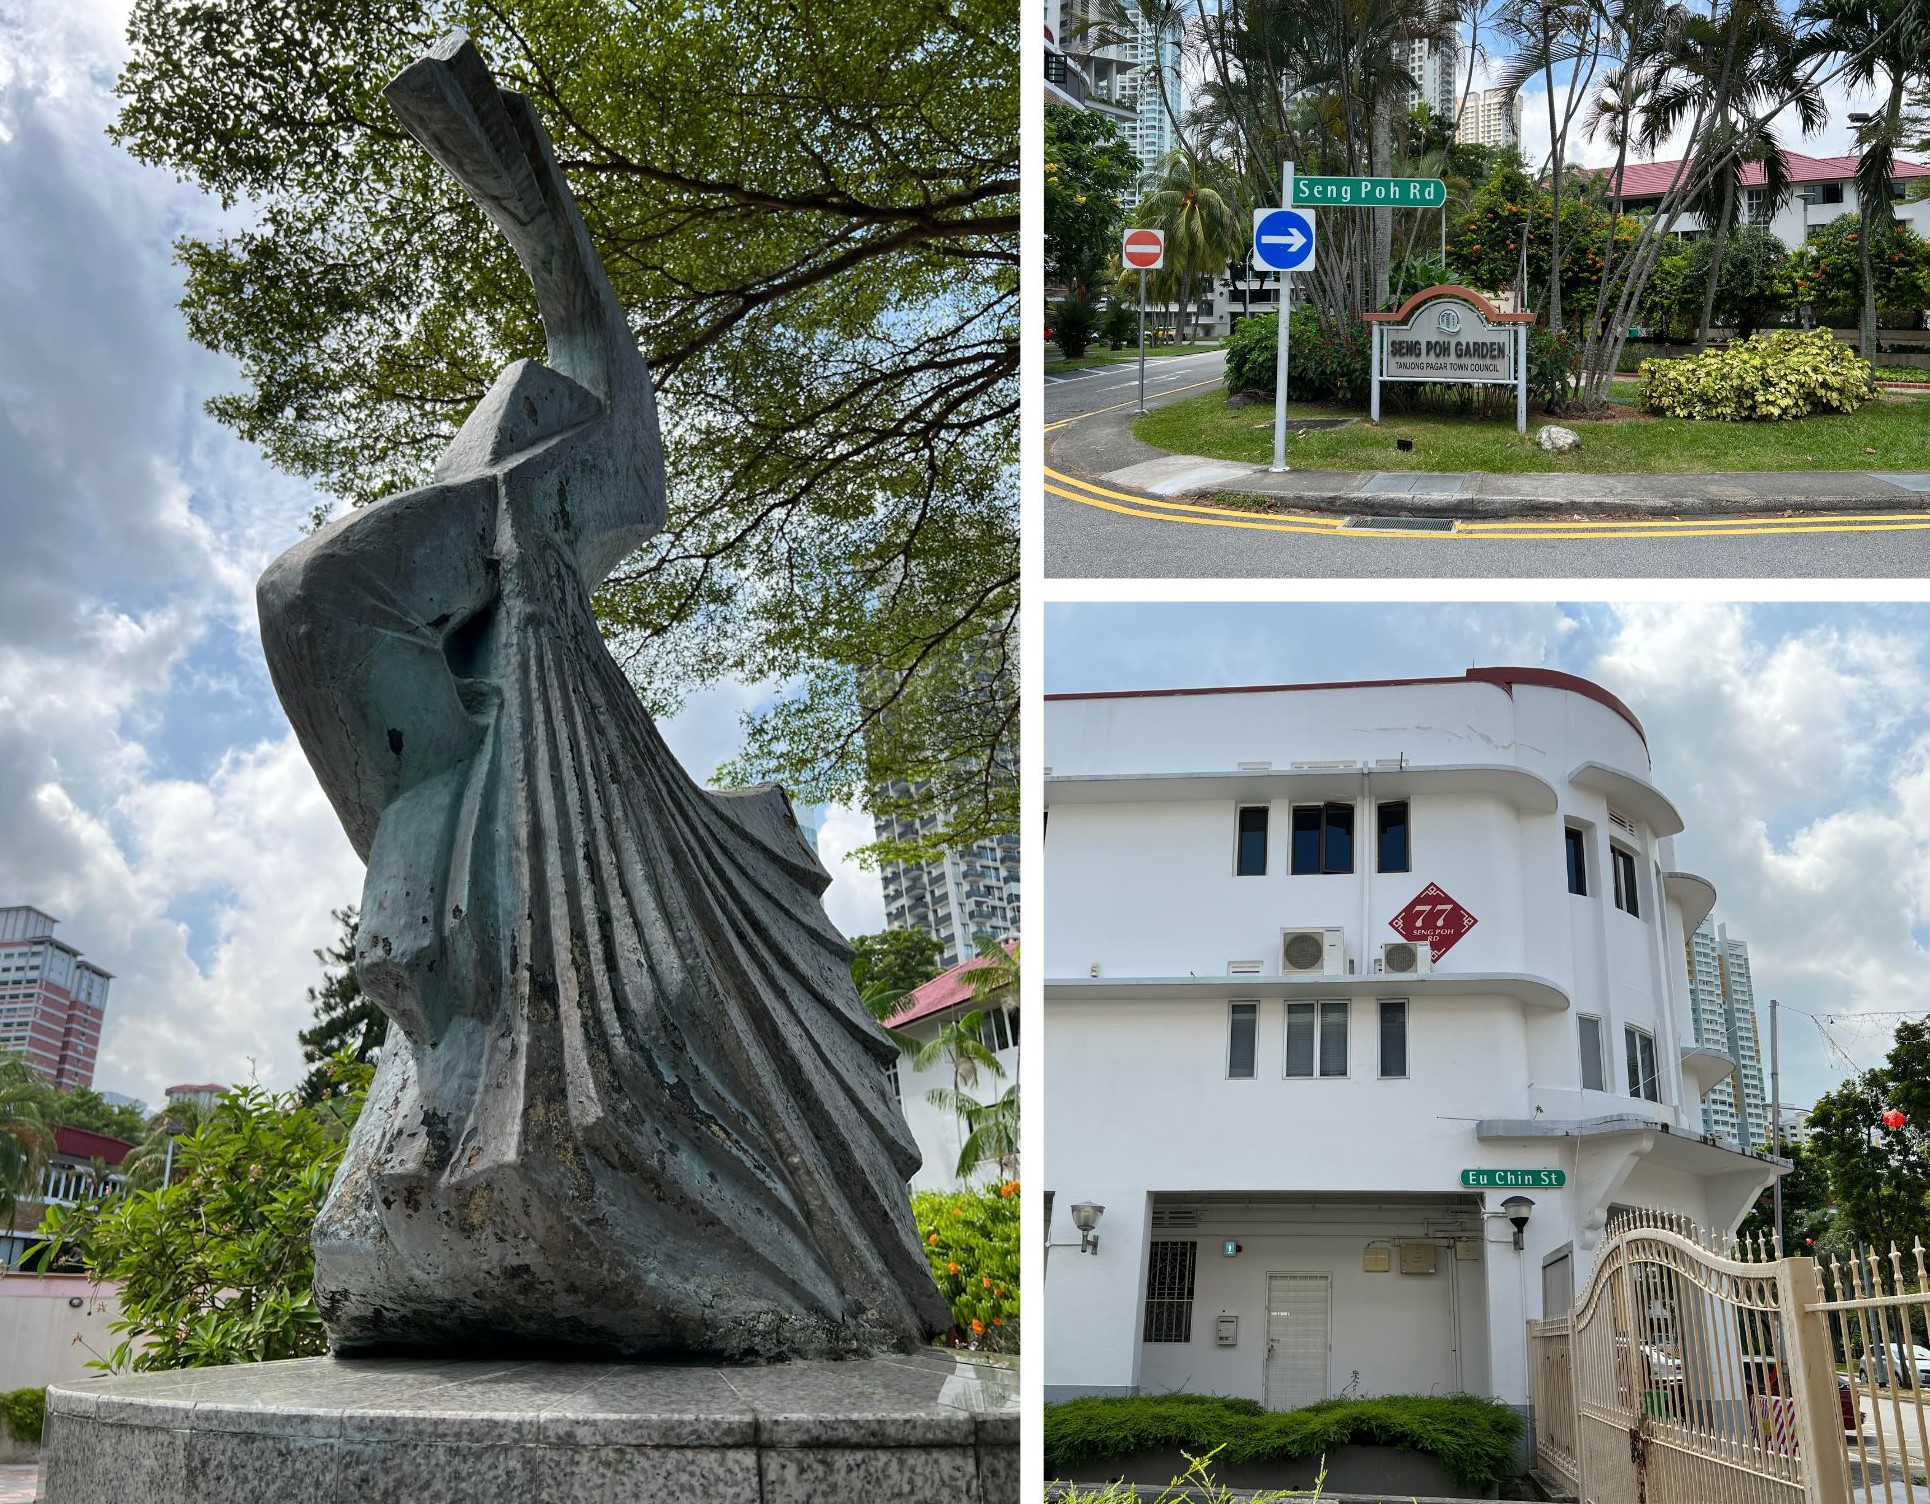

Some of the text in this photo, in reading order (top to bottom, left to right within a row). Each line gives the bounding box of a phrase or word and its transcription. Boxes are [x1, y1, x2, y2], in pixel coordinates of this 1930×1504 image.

[1299, 180, 1435, 203] Seng Poh Rd
[1390, 340, 1506, 359] SENG POH GARDEN
[1395, 361, 1500, 372] TANJONG PAGAR TOWN COUNCIL
[1412, 904, 1454, 928] 77
[1469, 1171, 1558, 1185] Eu Chin St
